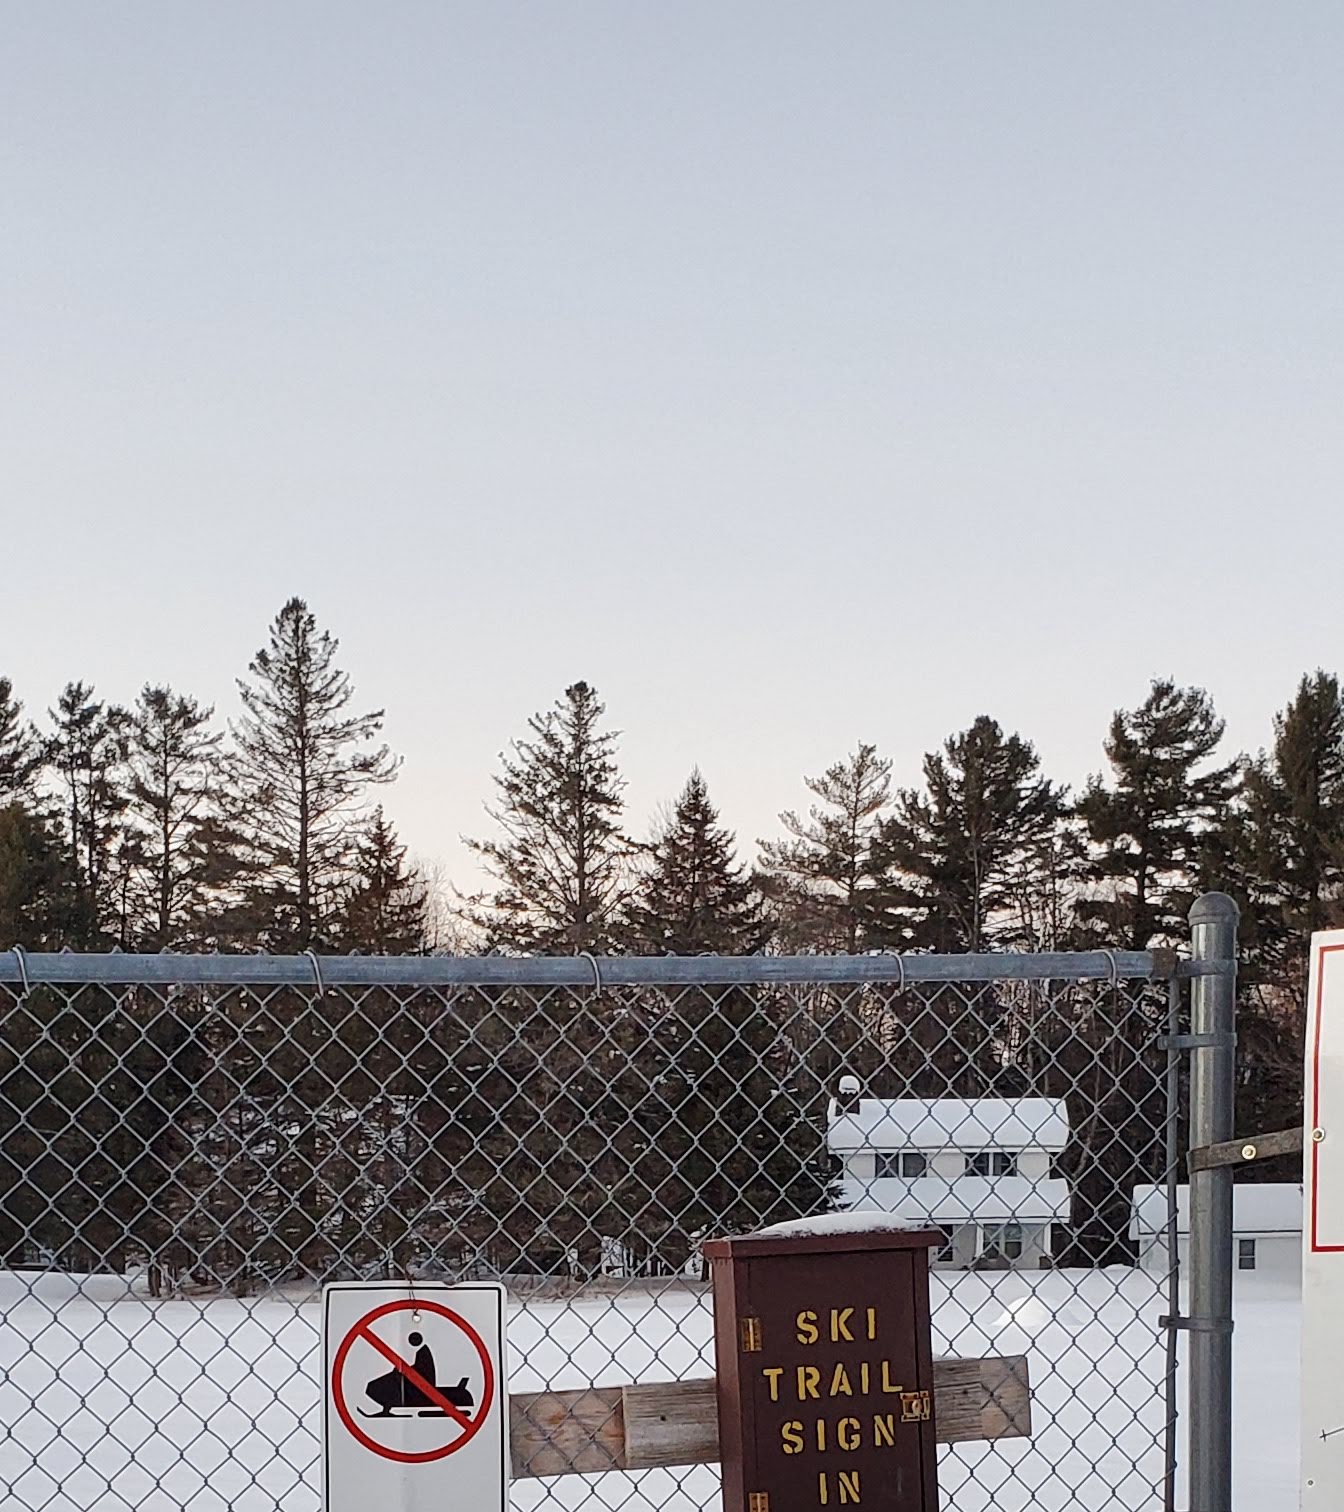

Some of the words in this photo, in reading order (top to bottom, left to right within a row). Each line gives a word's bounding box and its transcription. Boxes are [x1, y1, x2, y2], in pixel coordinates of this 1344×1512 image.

[796, 1307, 877, 1346] SKI
[762, 1360, 904, 1402] TRAIL
[780, 1414, 896, 1455] SIGN
[818, 1470, 861, 1506] IN
